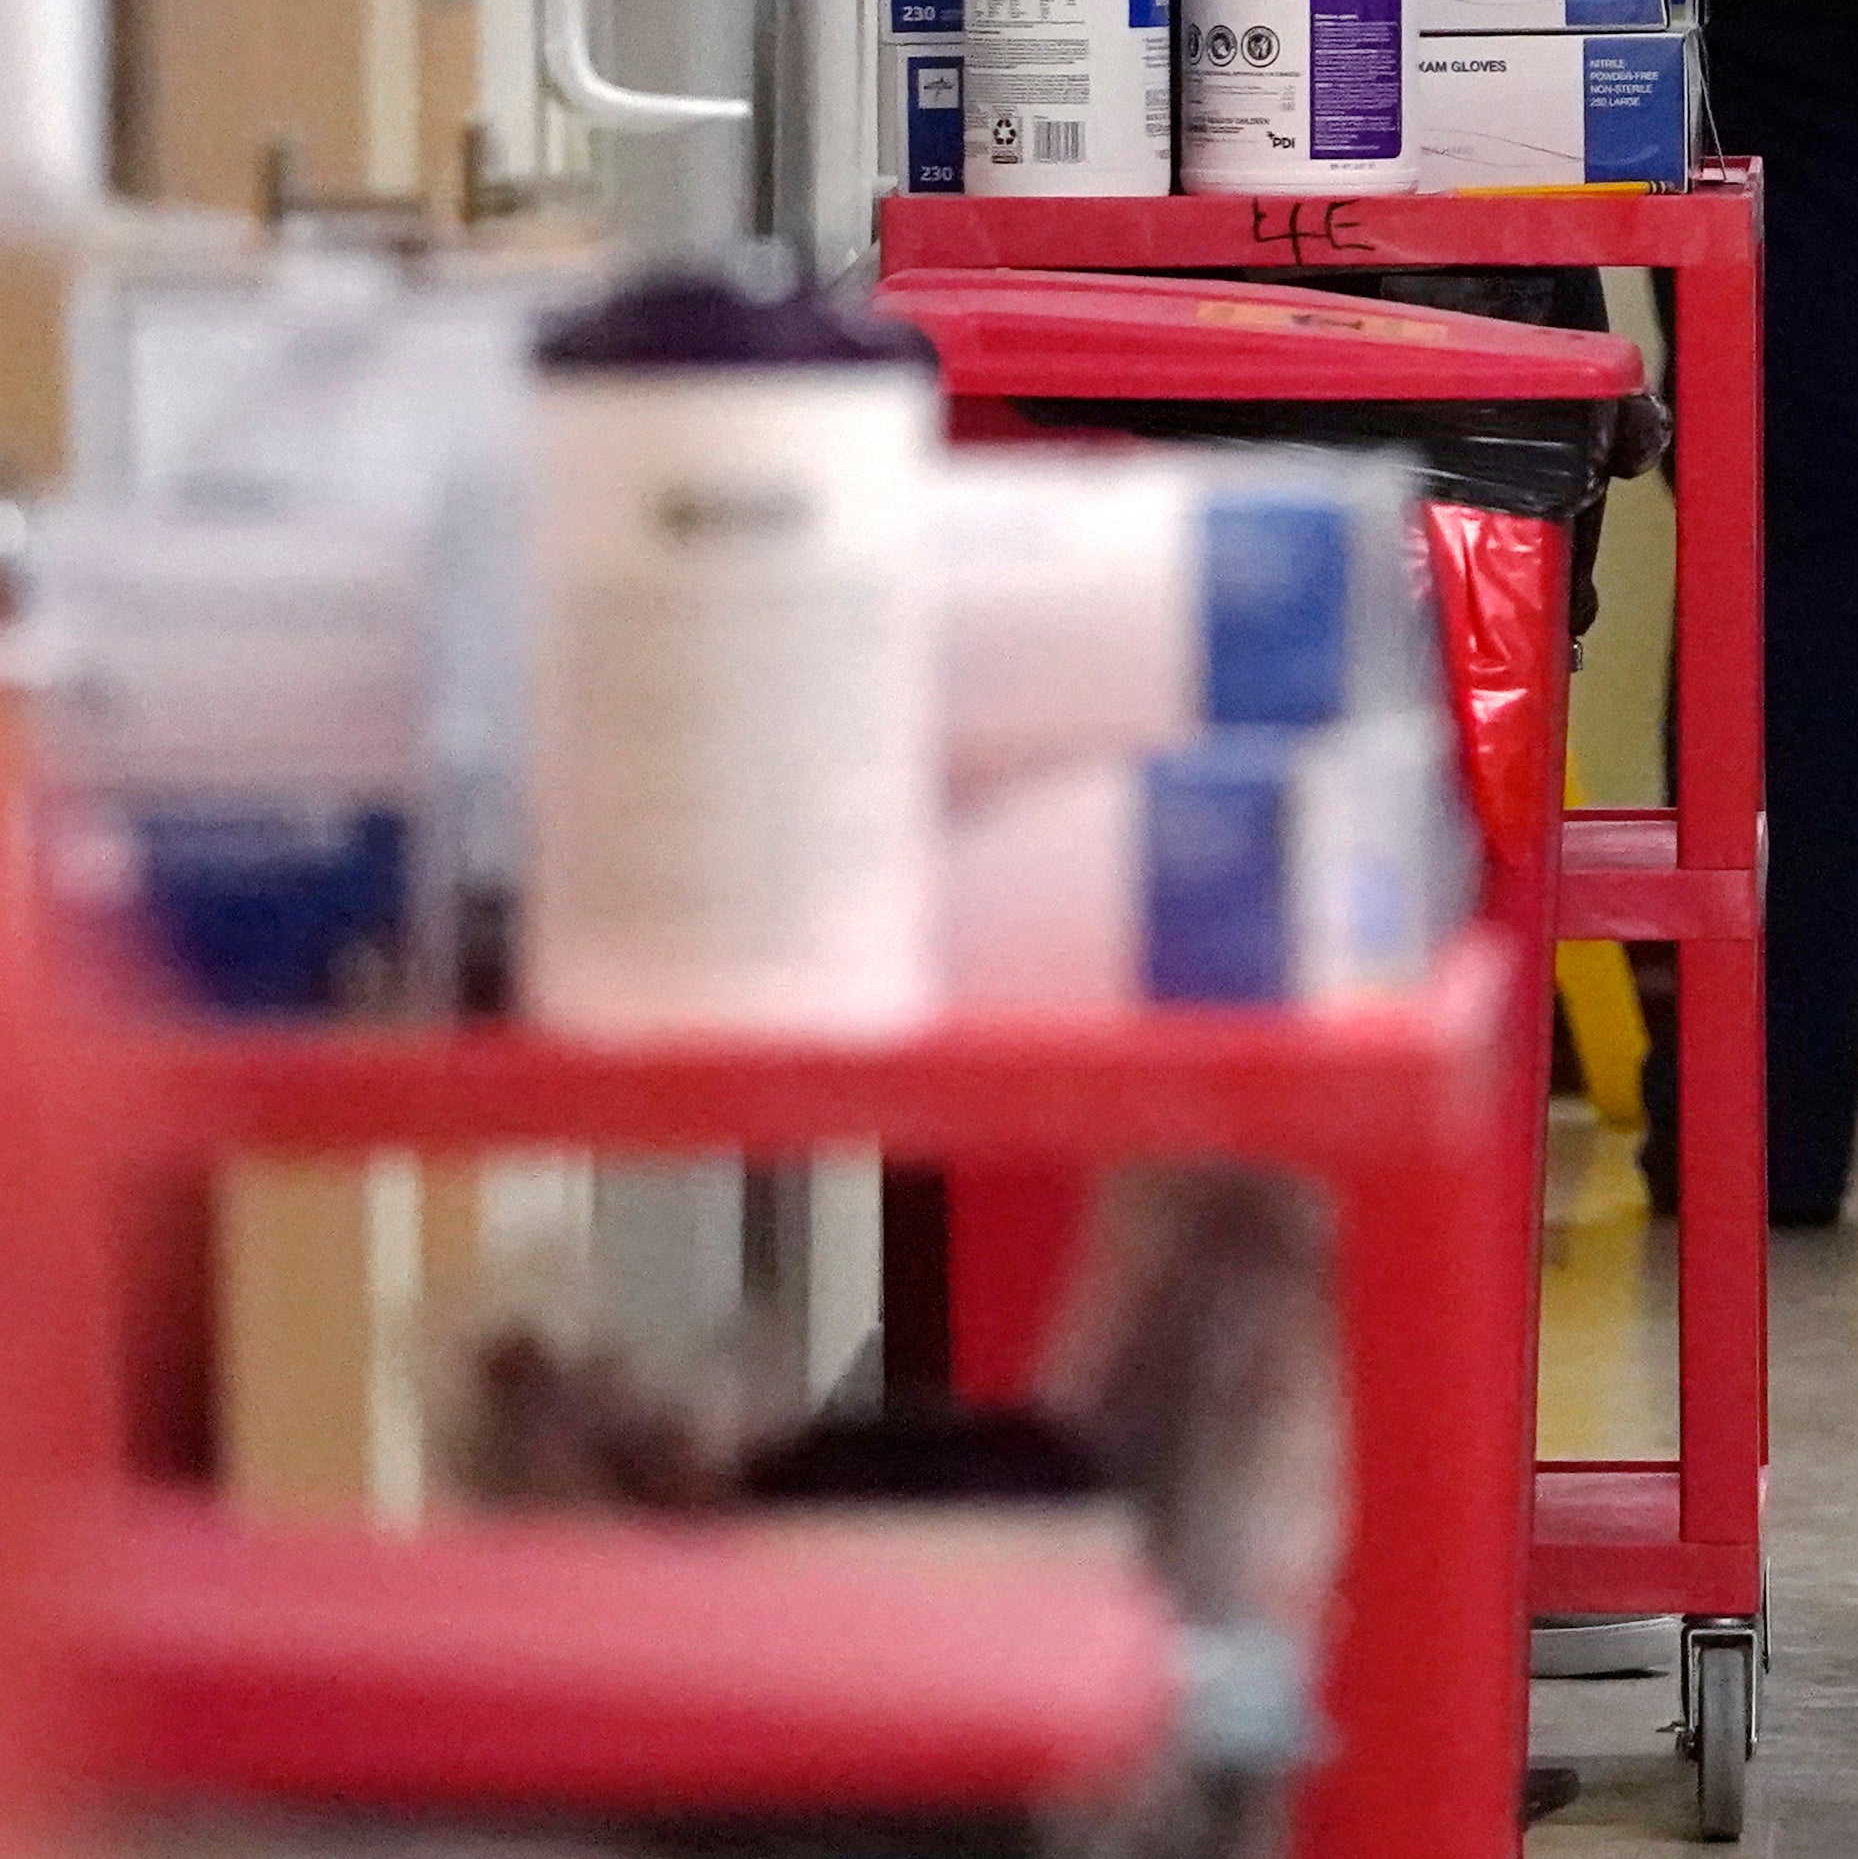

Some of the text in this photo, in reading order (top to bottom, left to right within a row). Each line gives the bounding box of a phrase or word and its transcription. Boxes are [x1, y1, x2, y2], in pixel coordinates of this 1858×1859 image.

[902, 5, 937, 22] 230
[1451, 60, 1508, 73] GLOVES
[1589, 58, 1625, 70] NITRILE
[1589, 71, 1660, 82] POWDER-FREE
[1589, 84, 1653, 94] NON-STERILE
[1272, 137, 1296, 149] PDI
[919, 166, 954, 182] 230
